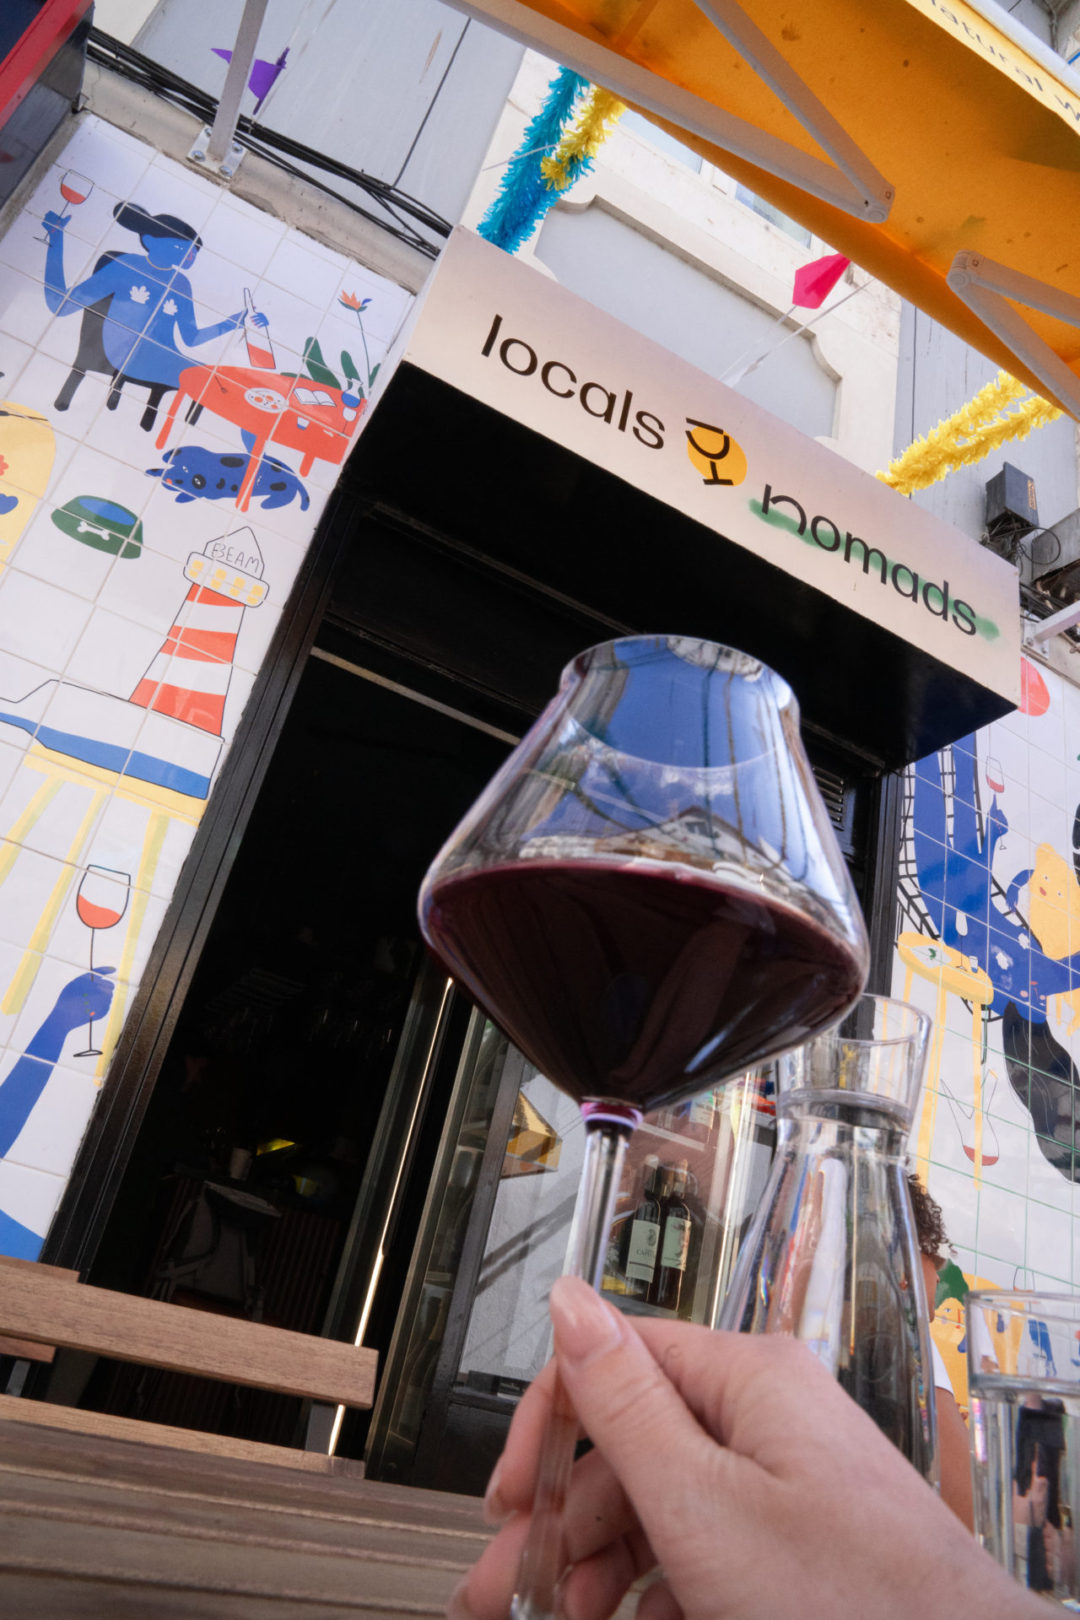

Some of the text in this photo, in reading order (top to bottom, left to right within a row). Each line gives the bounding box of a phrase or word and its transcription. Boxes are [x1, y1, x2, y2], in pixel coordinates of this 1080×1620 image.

[931, 0, 1044, 92] atural
[482, 314, 977, 637] locals nomads
[211, 542, 260, 574] BEAM
